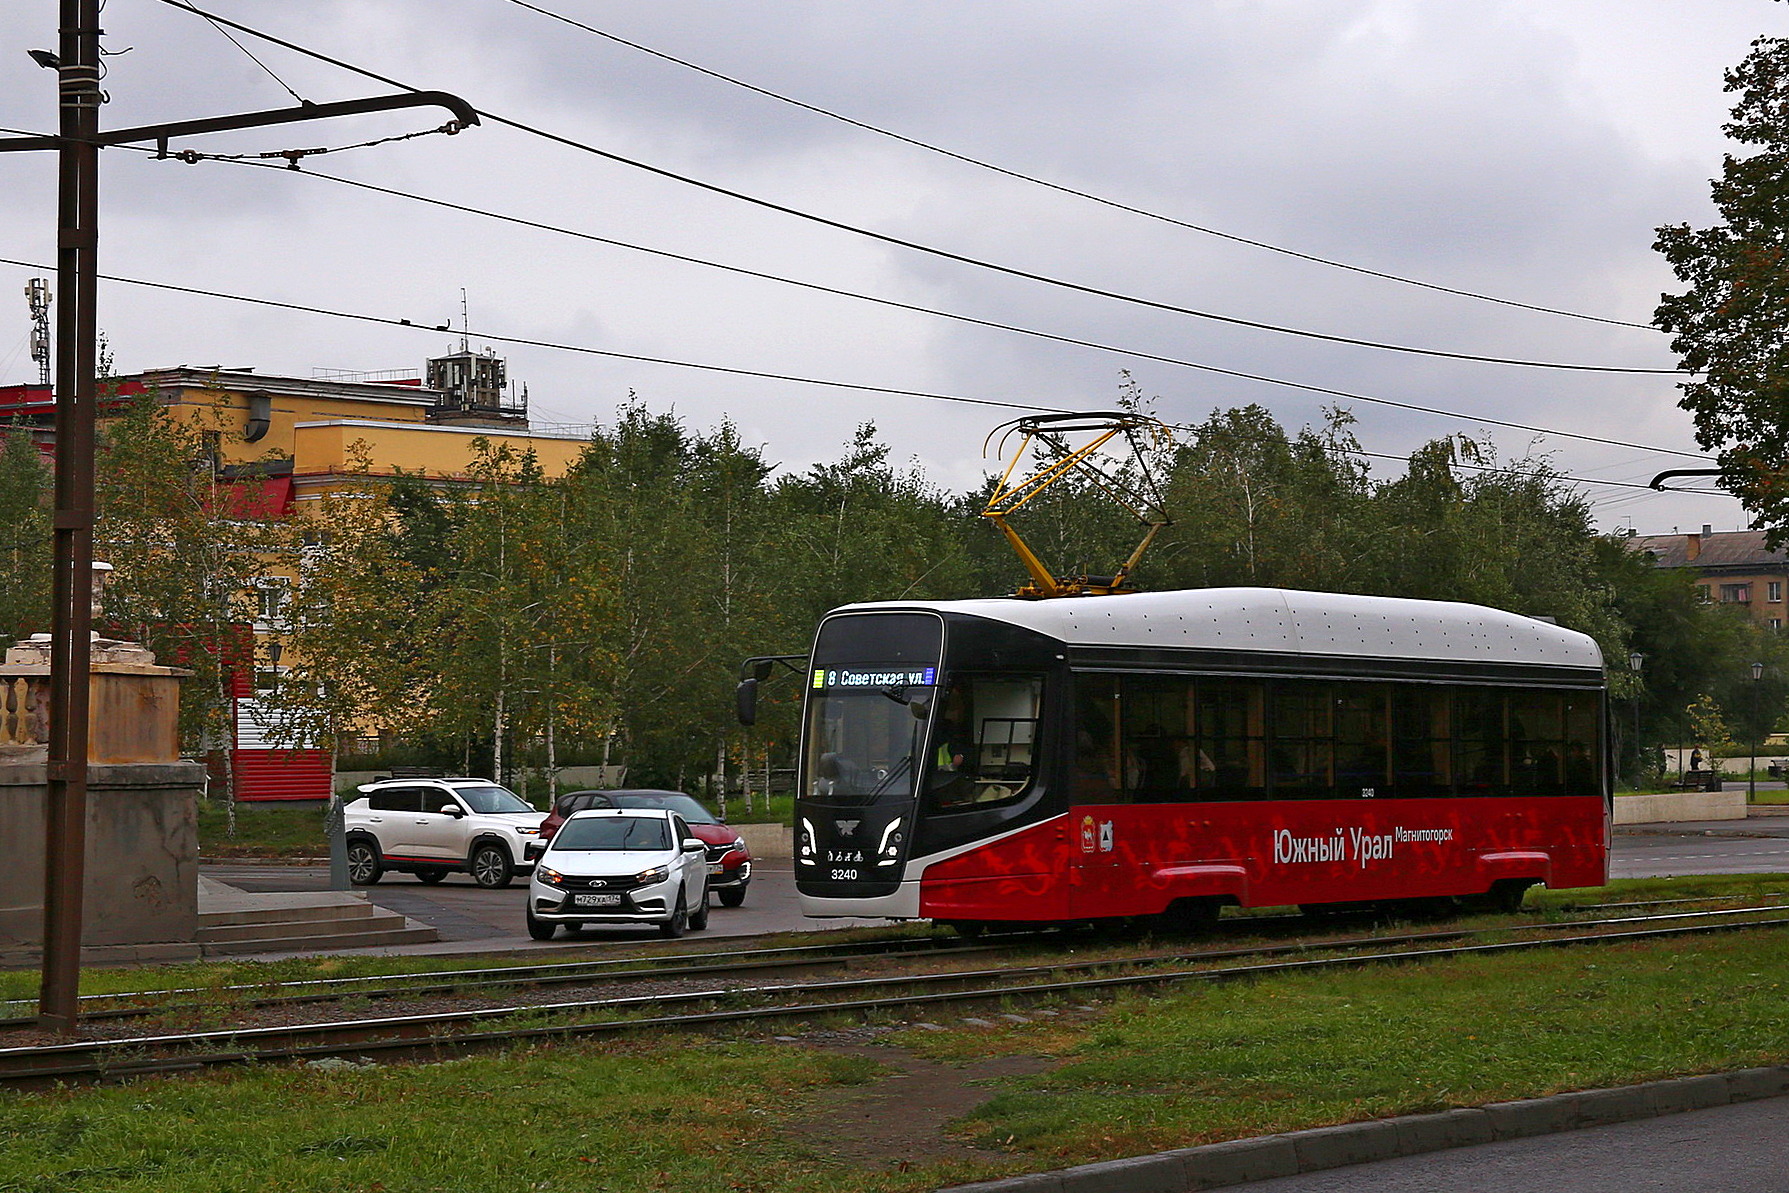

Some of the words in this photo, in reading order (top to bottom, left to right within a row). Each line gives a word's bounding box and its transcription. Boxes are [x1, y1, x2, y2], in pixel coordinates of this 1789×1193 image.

[828, 671, 836, 685] 8
[841, 671, 904, 685] Советская
[908, 672, 925, 685] ул.
[1395, 826, 1453, 845] Магнитогорск
[1274, 828, 1345, 864] Южный
[1350, 827, 1393, 869] Урал
[831, 869, 858, 880] 3240
